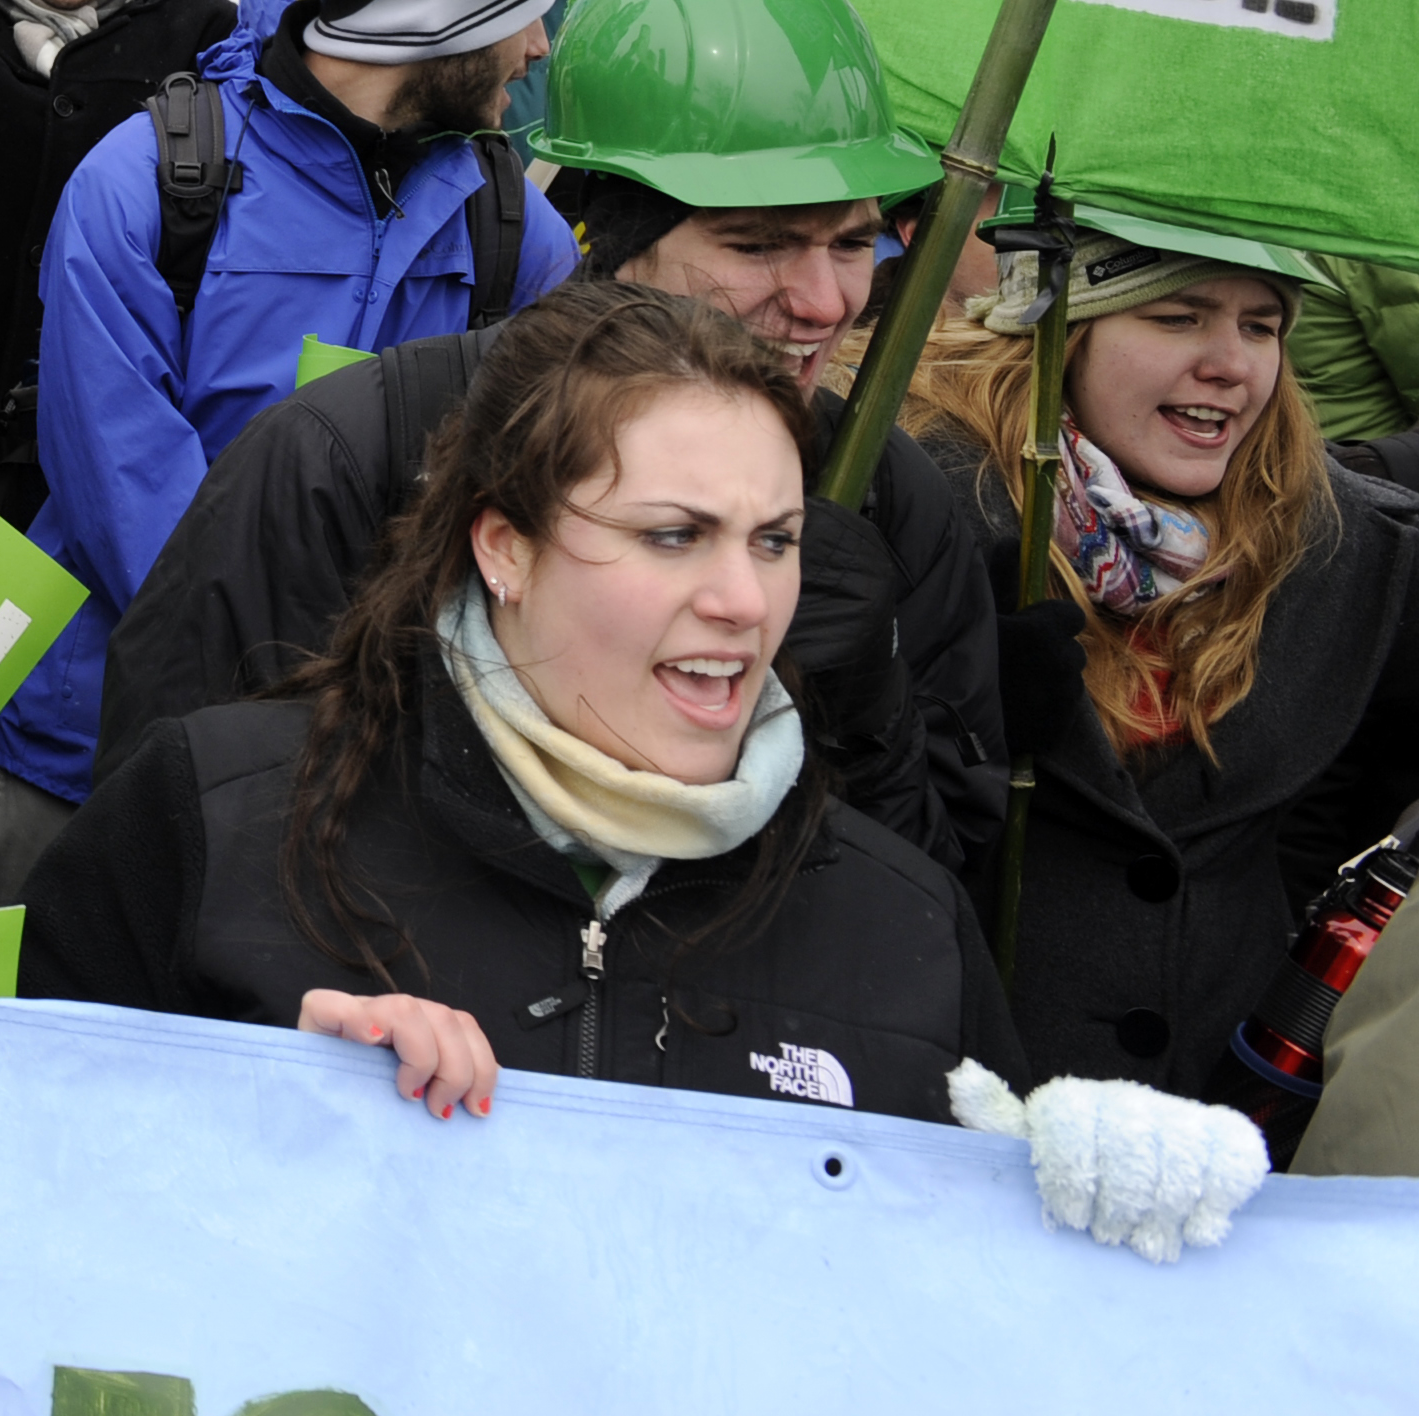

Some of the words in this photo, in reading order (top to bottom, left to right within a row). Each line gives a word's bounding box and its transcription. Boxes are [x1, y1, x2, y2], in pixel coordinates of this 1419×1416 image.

[779, 1042, 817, 1064] THE
[749, 1051, 817, 1081] NORTH
[770, 1074, 821, 1099] FACE
